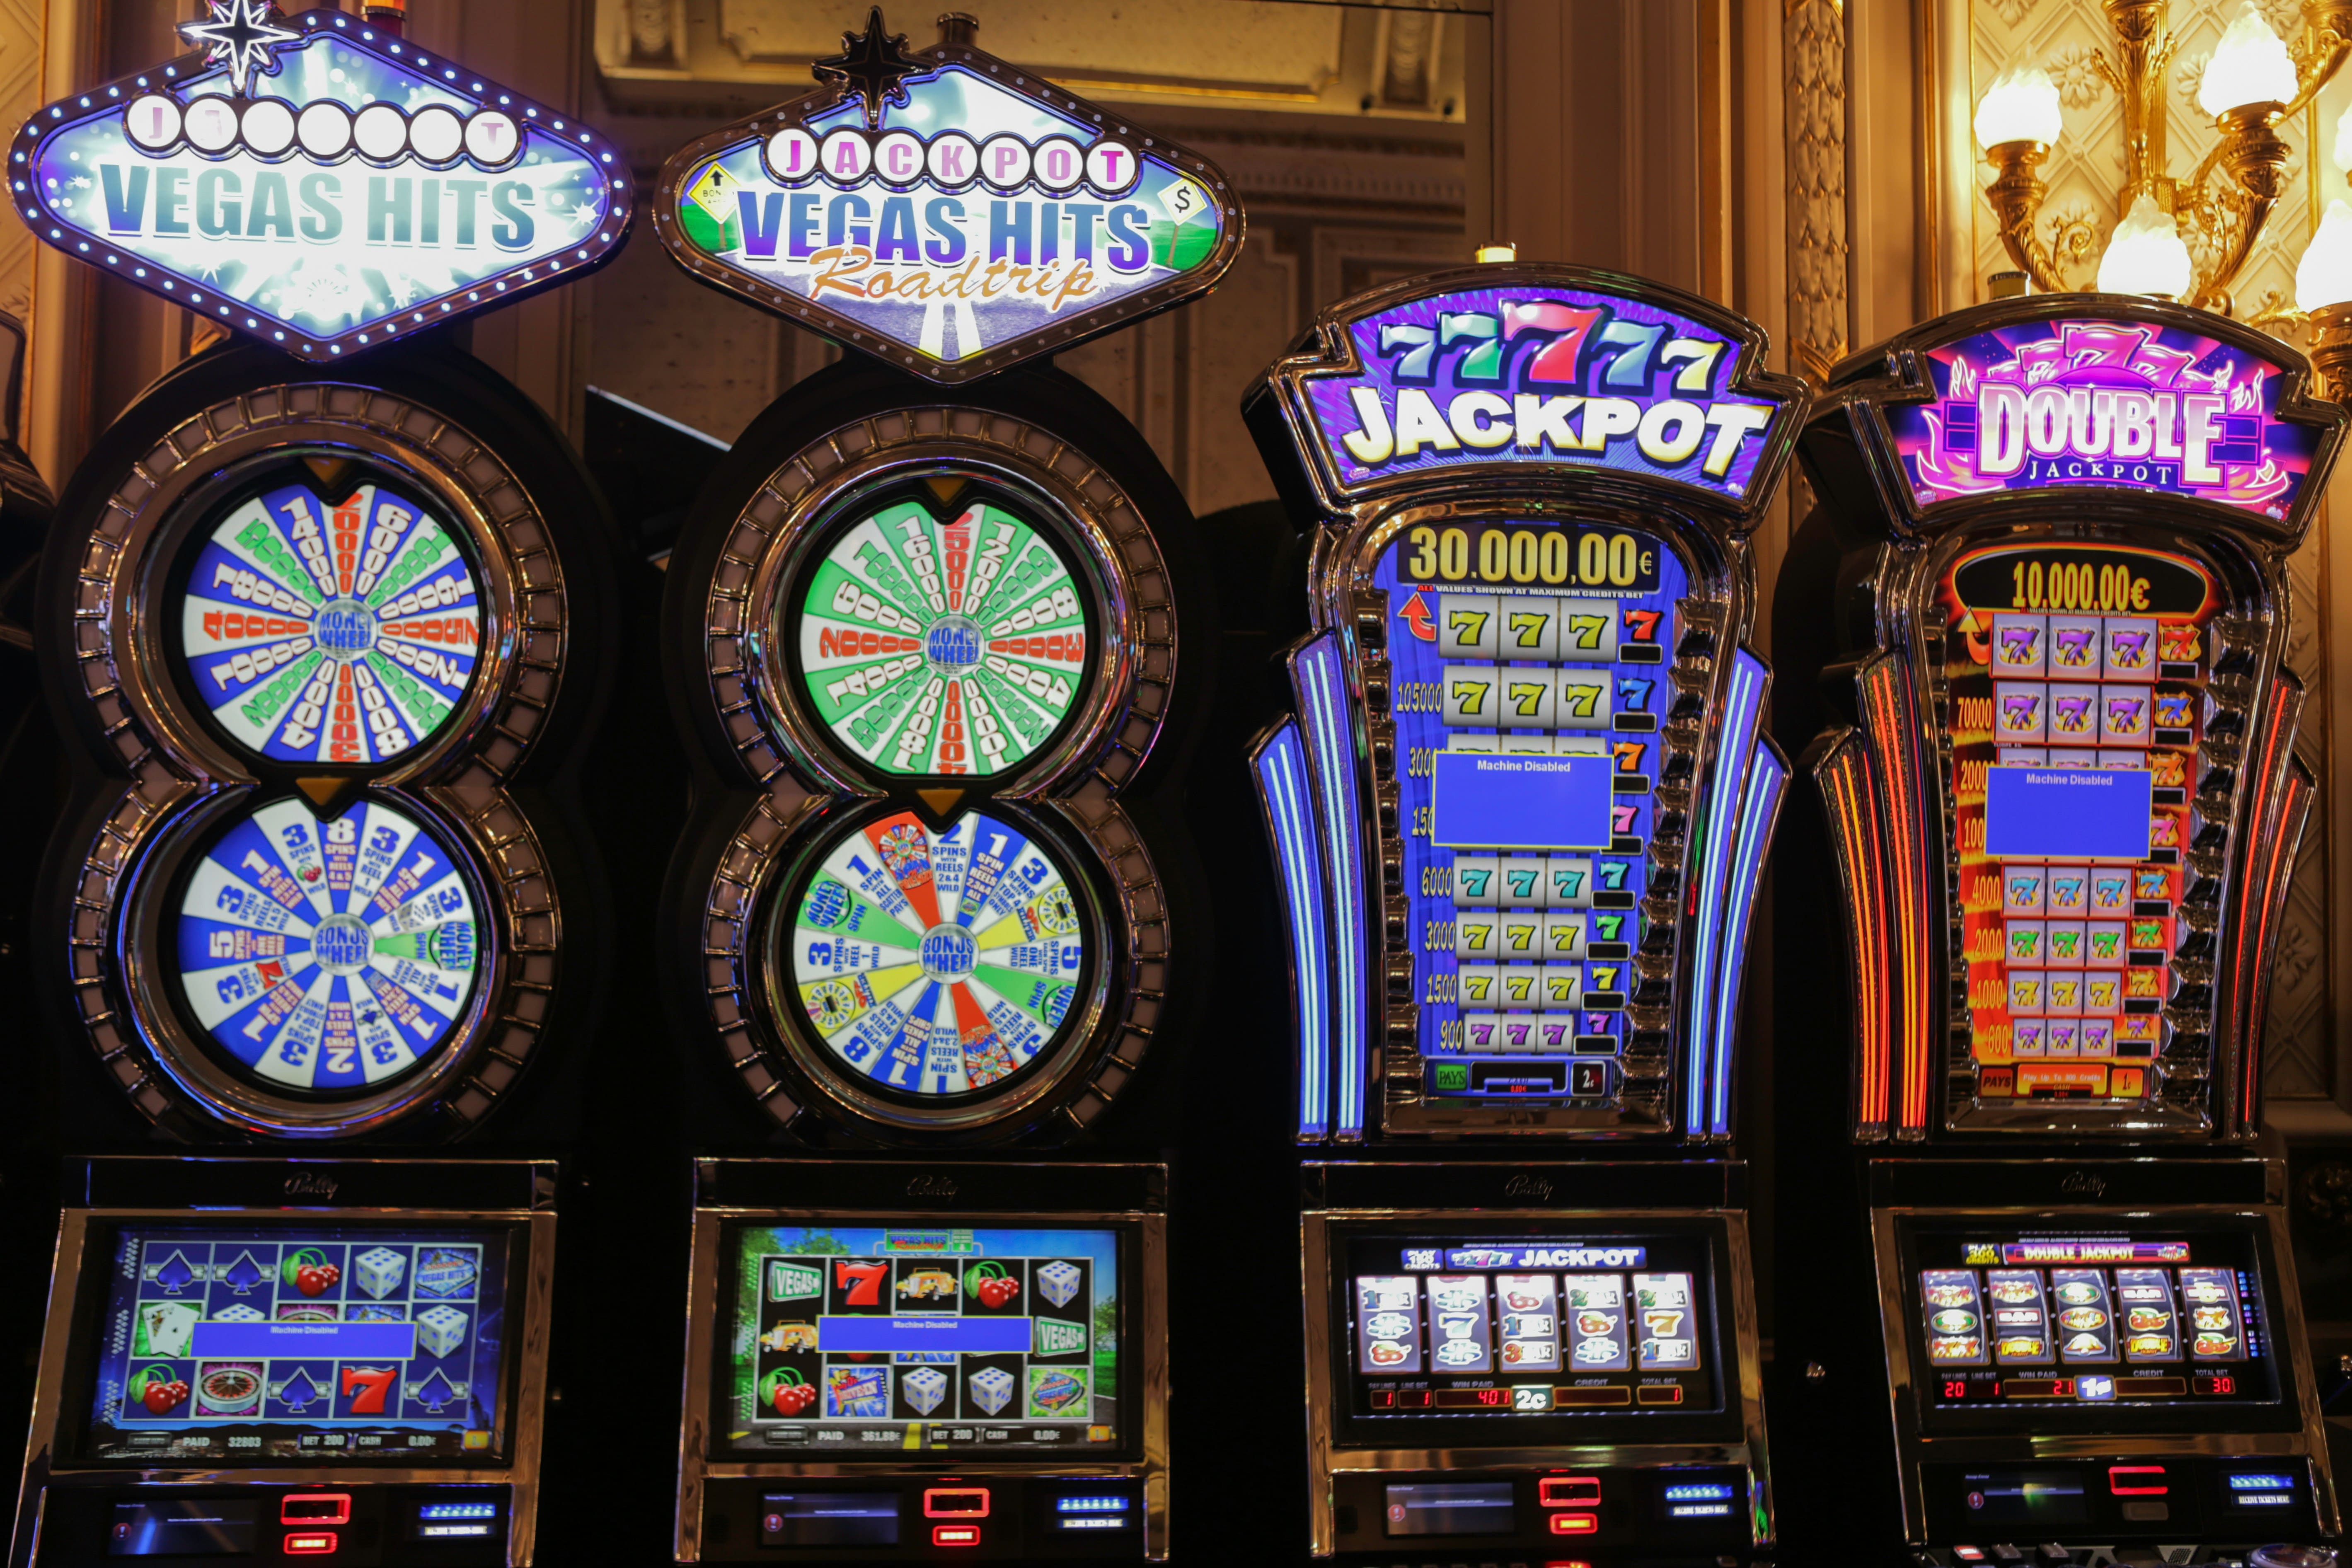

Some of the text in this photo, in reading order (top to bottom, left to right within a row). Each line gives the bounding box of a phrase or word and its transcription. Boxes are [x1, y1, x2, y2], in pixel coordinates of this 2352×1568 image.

[785, 139, 1124, 183] JACKPOT
[100, 164, 536, 250] VEGAS HITS
[738, 191, 1152, 271] VEGAS HITS
[809, 245, 1099, 312] Roadtrip
[1341, 385, 1774, 477] JACKPOT
[1977, 382, 2227, 488] DOUBLE
[2030, 461, 2172, 484] JACKPOT
[1436, 585, 1473, 594] VALUES
[1476, 586, 1512, 595] SHOWN
[1529, 588, 1580, 597] MAXIMUM
[1582, 590, 1624, 599] CREDITS
[203, 611, 308, 641] 40000
[820, 627, 921, 658] 20000
[1397, 682, 1443, 713] 105000
[1958, 697, 1992, 729] 70000
[1477, 760, 1570, 772] Machine Disabled
[2026, 773, 2112, 786] Machine Disabled
[371, 826, 400, 854] 3
[990, 832, 1008, 858] 1
[932, 847, 967, 857] SPINS
[977, 852, 1005, 872] SPIN
[846, 854, 871, 877] 1
[935, 863, 963, 872] REELS
[969, 867, 998, 887] REELS
[1021, 857, 1048, 885] 3
[860, 868, 884, 891] SPIN
[1008, 870, 1035, 899] SPINS
[1422, 866, 1452, 897] 6000
[1972, 876, 2000, 905] 4000
[217, 886, 244, 914] 3
[875, 884, 891, 900] ALL
[966, 888, 982, 902] ALL
[847, 904, 867, 932] SPIN
[924, 935, 973, 954] BONUS
[1425, 921, 1456, 952] 3000
[1975, 928, 2002, 959] 2000
[808, 943, 831, 965] 3
[1426, 974, 1457, 1004] 1500
[1976, 979, 2004, 1010] 1000
[1440, 1020, 1463, 1050] 900
[1989, 1024, 2008, 1054] 600
[844, 1036, 870, 1063] 8
[1439, 1070, 1465, 1085] PAYS
[1983, 1075, 2011, 1088] PAYS
[1518, 1249, 1639, 1267] JACKPOT
[2023, 1246, 2135, 1261] DOUBLE JACKPOT
[776, 1267, 814, 1296] VEGAS
[270, 1325, 339, 1335] Machine Disabled
[893, 1321, 958, 1330] Machine Disabled
[1040, 1323, 1077, 1351] VEGAS
[1575, 1379, 1608, 1387] CREDIT
[1945, 1382, 1964, 1397] 20
[2053, 1380, 2072, 1394] 21
[2213, 1378, 2231, 1392] 30
[1478, 1390, 1509, 1404] 401
[182, 1437, 210, 1447] PAID
[818, 1430, 844, 1442] PAID
[953, 1429, 972, 1440] 200
